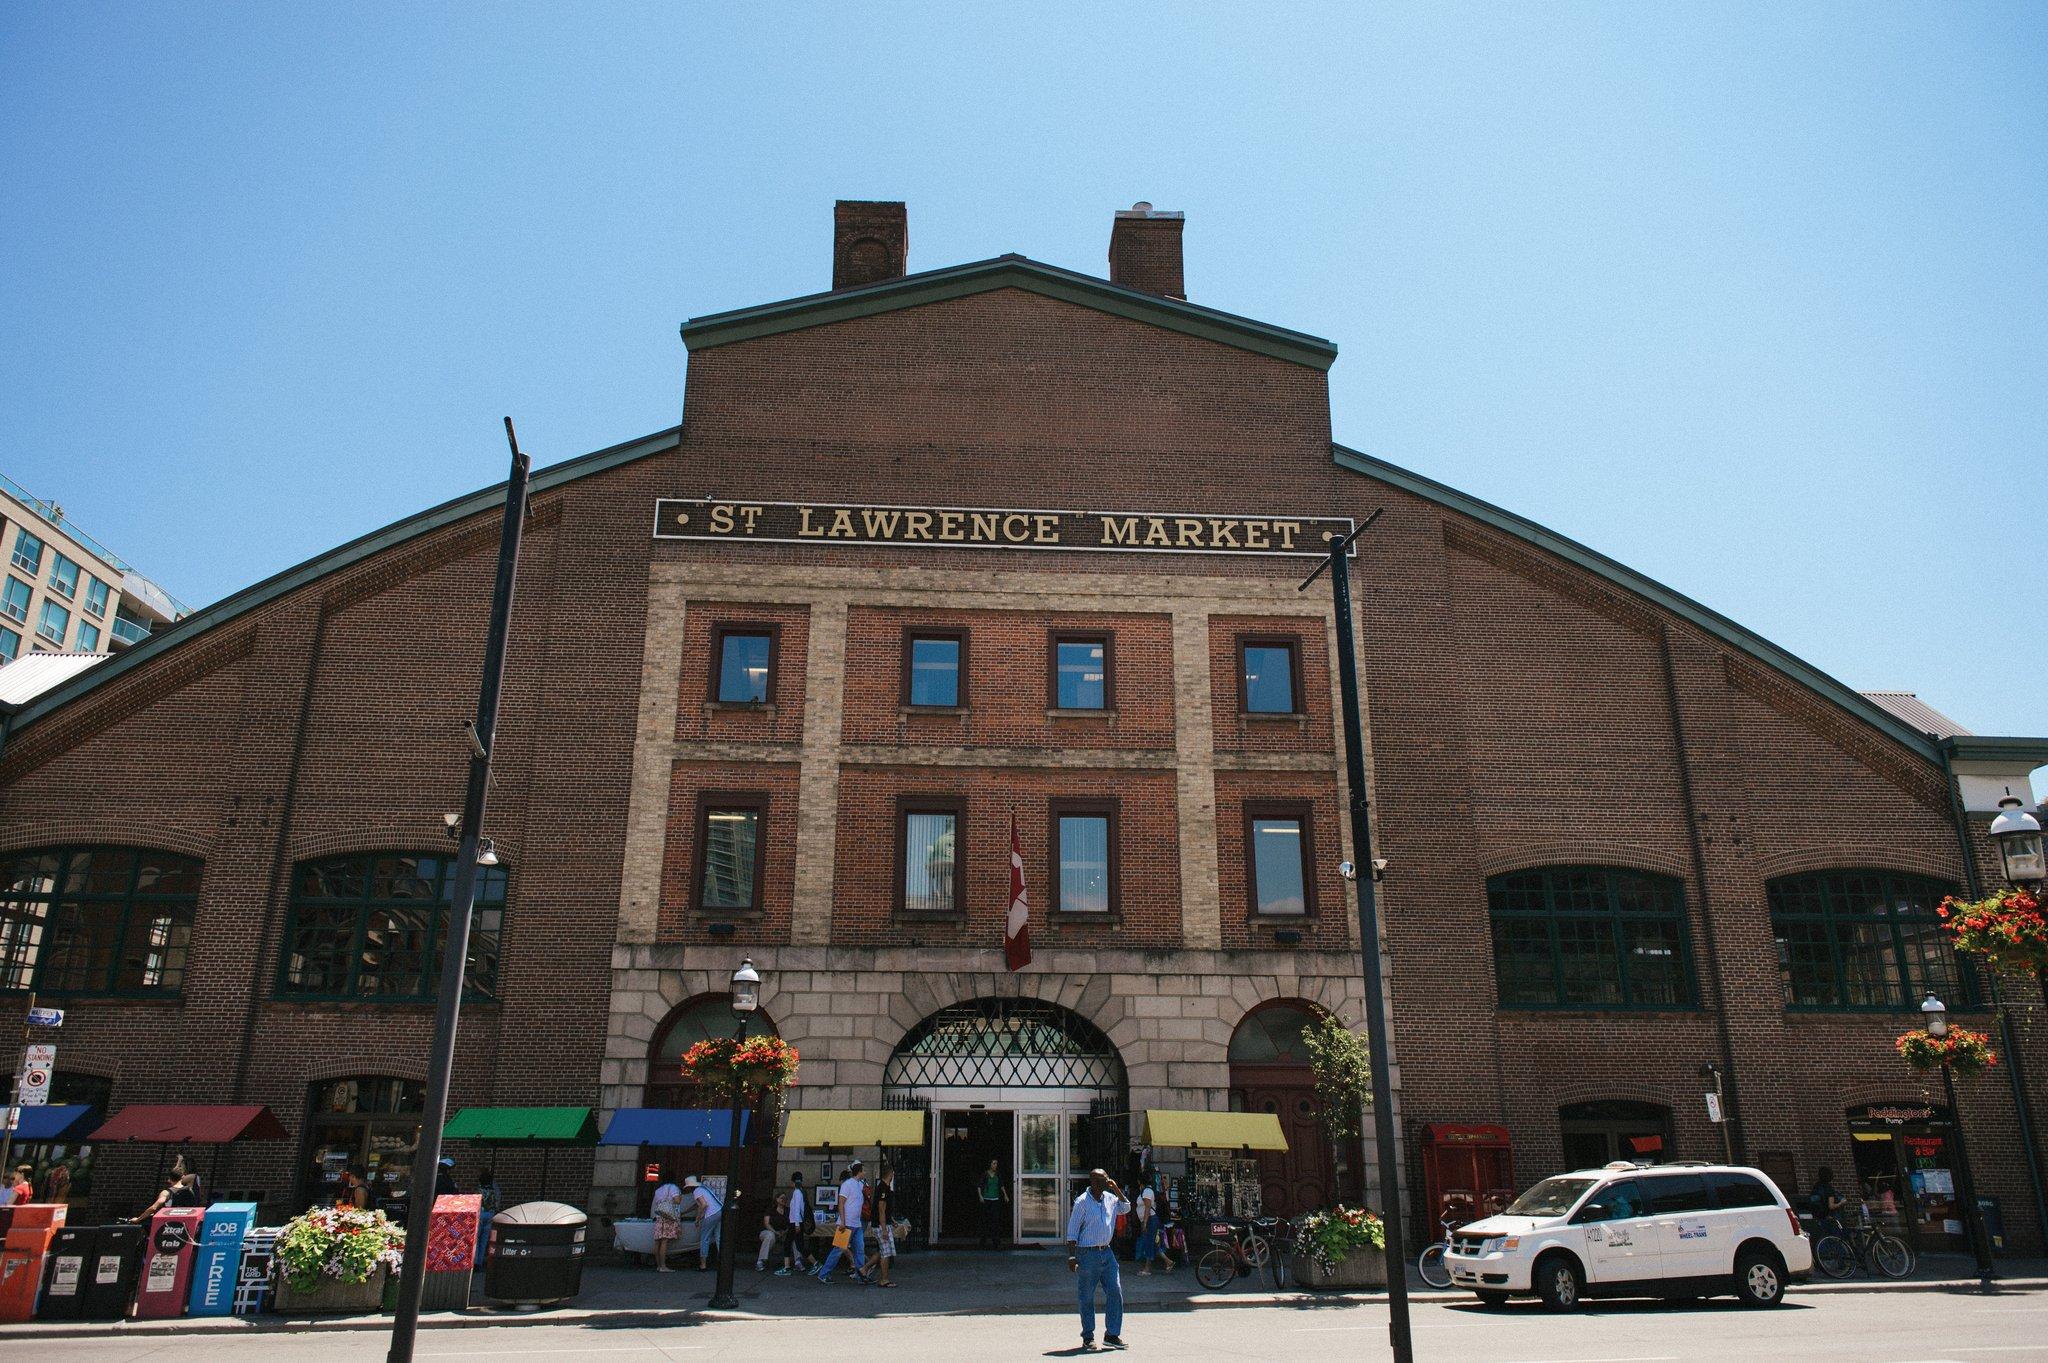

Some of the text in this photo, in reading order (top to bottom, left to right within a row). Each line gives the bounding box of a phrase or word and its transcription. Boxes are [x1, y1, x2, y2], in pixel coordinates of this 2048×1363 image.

[798, 508, 1059, 542] LAWRENCE
[1101, 516, 1300, 548] MARKET
[27, 1053, 54, 1061] STANDING
[1903, 1136, 1943, 1145] Restaurant
[163, 1226, 184, 1234] Xtra!
[211, 1222, 238, 1233] JOB
[503, 1247, 517, 1256] Litter
[205, 1252, 226, 1306] FREE
